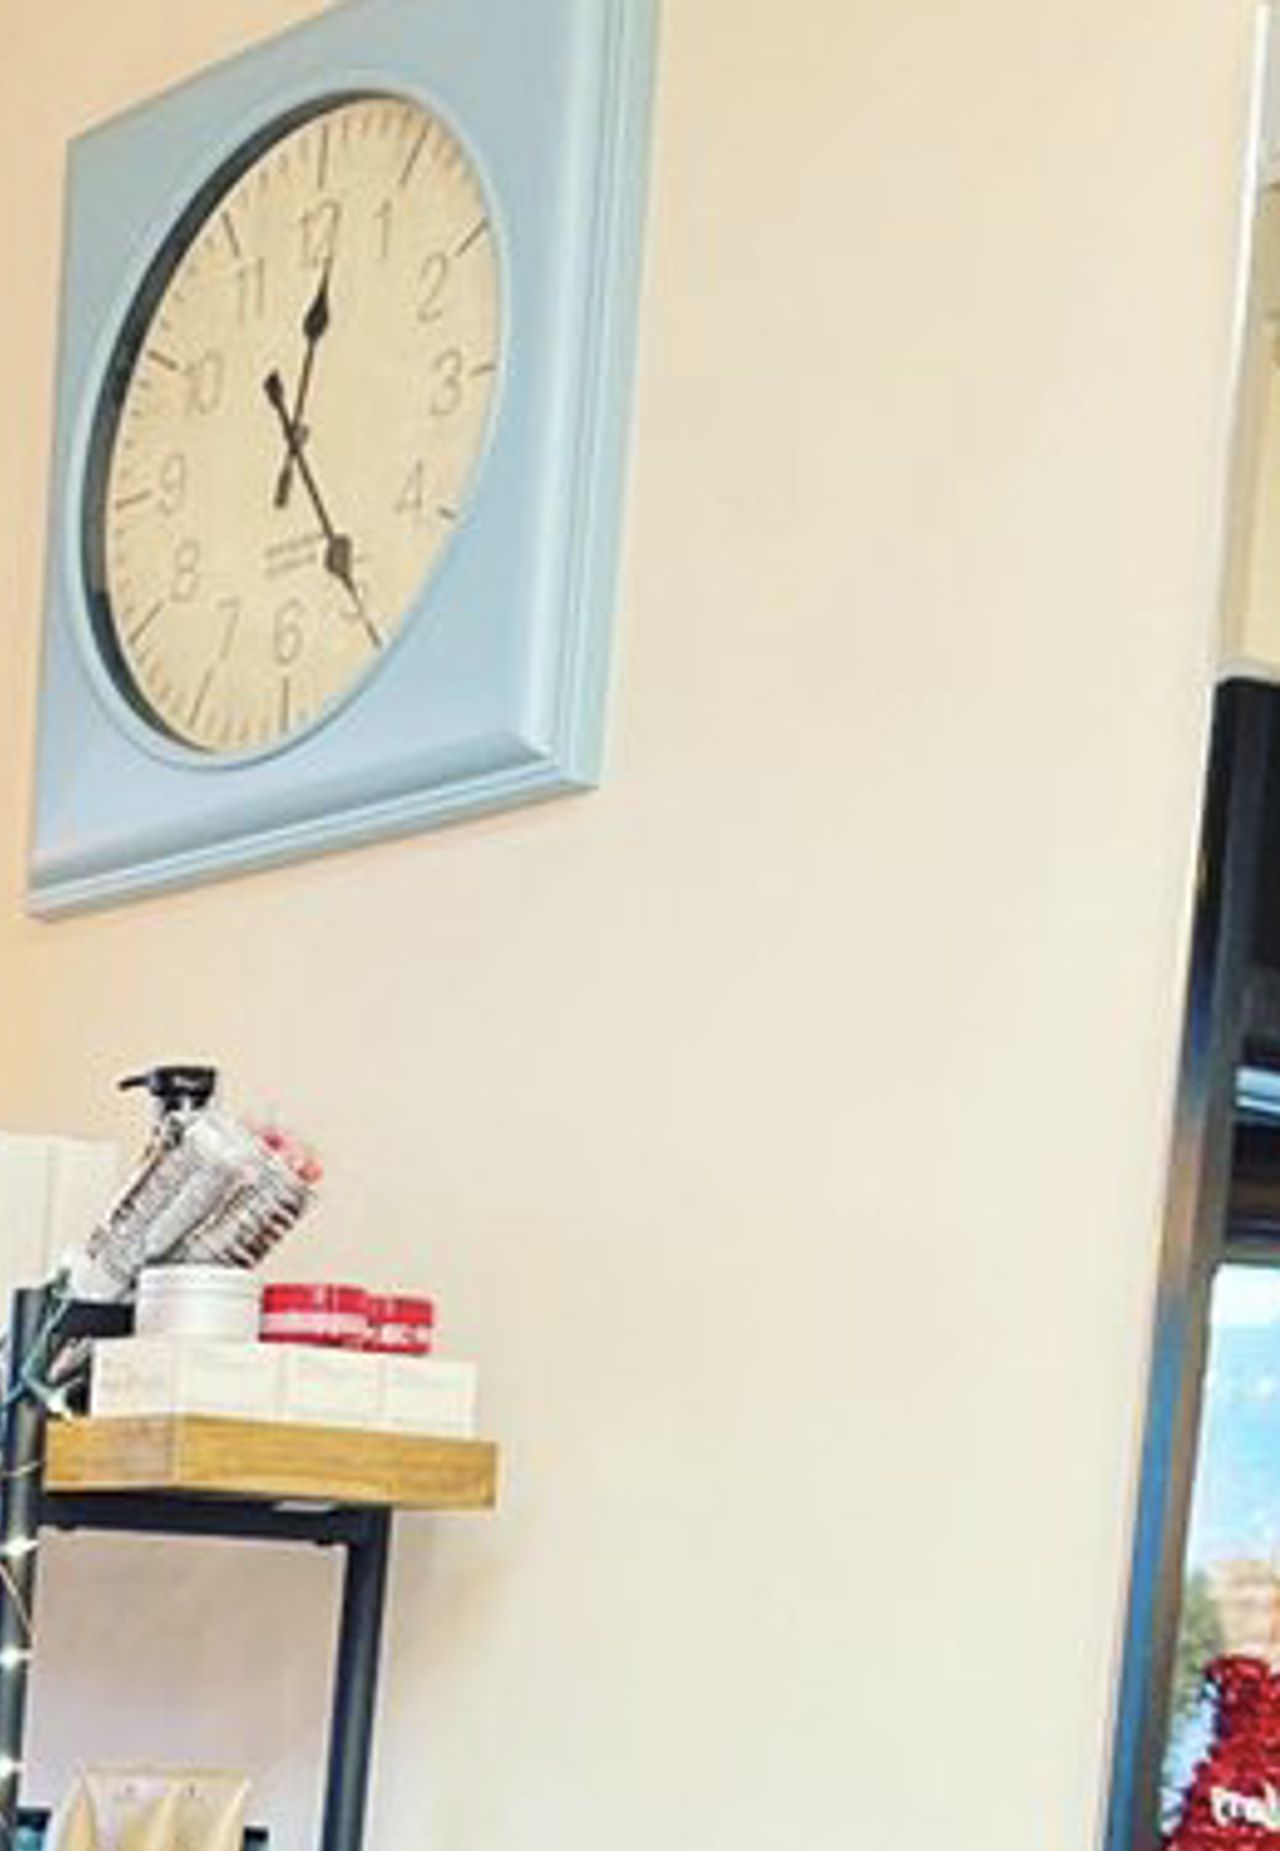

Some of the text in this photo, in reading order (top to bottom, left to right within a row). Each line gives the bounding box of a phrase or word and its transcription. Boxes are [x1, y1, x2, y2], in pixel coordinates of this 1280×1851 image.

[375, 200, 393, 260] 1
[237, 256, 267, 325] 11
[418, 251, 449, 324] 2
[184, 350, 226, 414] 10
[431, 347, 462, 416] 3
[159, 454, 186, 517] 9
[395, 458, 425, 519] 4
[173, 540, 201, 602] 8
[215, 594, 240, 660] 7
[273, 598, 305, 666] 6
